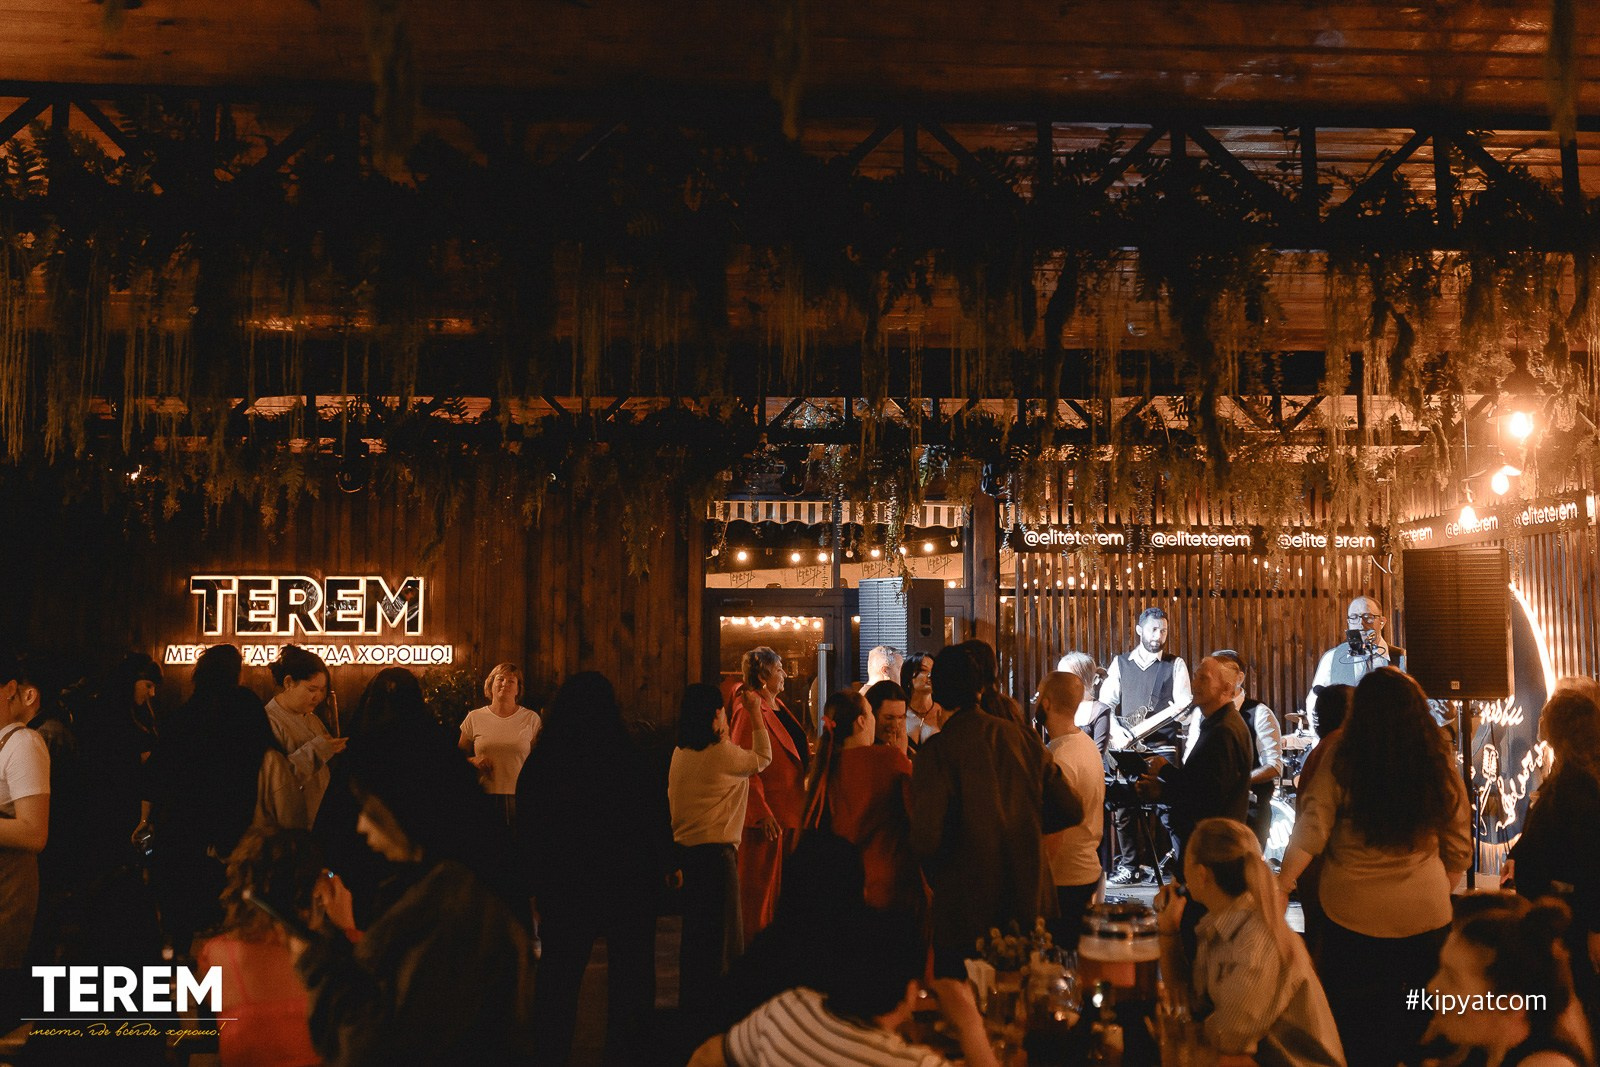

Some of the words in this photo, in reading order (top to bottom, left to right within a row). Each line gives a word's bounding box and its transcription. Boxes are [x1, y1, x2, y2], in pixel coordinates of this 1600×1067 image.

[1445, 515, 1499, 539] @elerem
[1151, 530, 1251, 548] @eliteterem
[1277, 531, 1376, 549] @eliteerem
[190, 575, 425, 636] TEREM
[165, 646, 208, 663] МЕС
[243, 646, 277, 664] ГДЕ
[357, 646, 451, 665] ХОРОШО!
